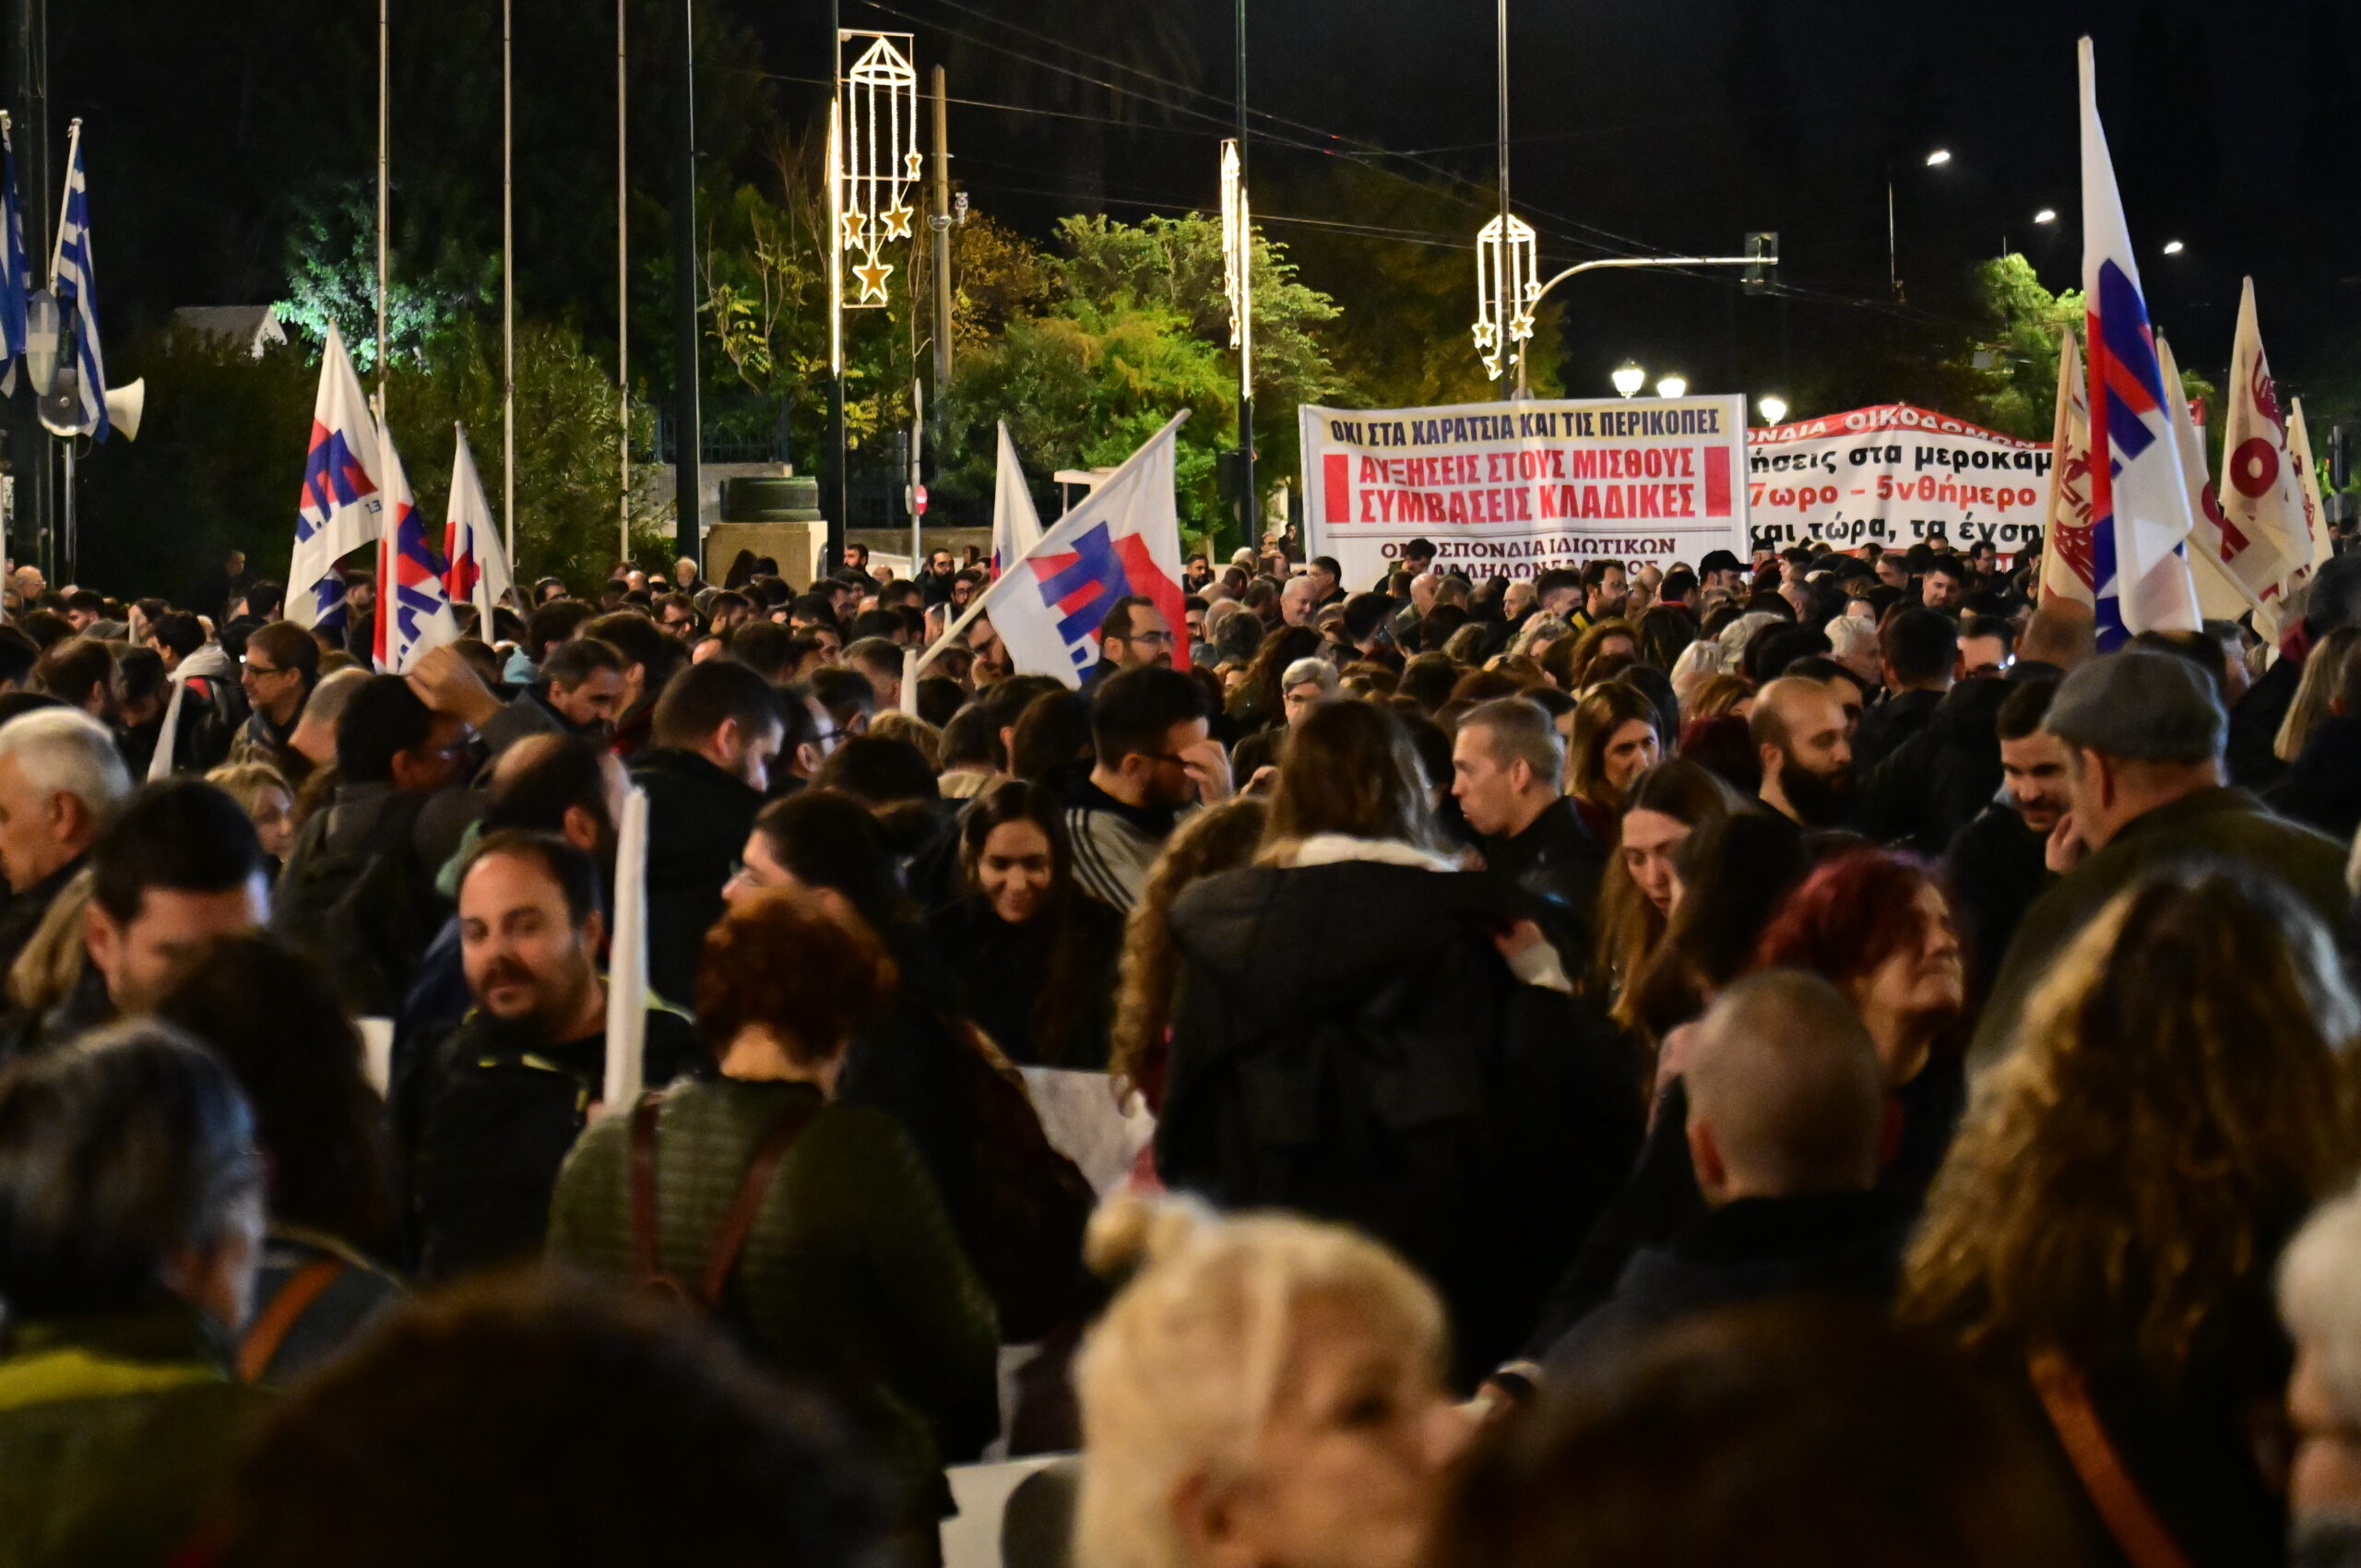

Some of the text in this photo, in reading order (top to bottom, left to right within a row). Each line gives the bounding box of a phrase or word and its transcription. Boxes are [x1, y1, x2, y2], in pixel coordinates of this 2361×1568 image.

[1369, 422, 1406, 447] ΣΤΑ
[1412, 413, 1515, 445] ΧΑΡΑΤΣΙΑ
[1520, 411, 1557, 438] ΚΑΙ
[1561, 411, 1595, 436] ΤΙΣ
[1600, 408, 1720, 436] ΠΕΡΙΚΟΠΕΣ
[1359, 446, 1695, 487] ΑΥΞΗΣΕΙΣ ΣΤΟΥΣ ΜΙΣΘΟΥΣ
[1748, 447, 1837, 474] ήσεις
[1849, 445, 1902, 466] στα
[1359, 482, 1696, 525] ΣΥΜΒΑΣΕΙΣ ΚΛΑΔΙΚΕΣ
[1749, 482, 1838, 512] 7ωρο
[1876, 473, 2037, 513] 5νθήμερο
[1808, 511, 1896, 544] τώρα,
[1910, 519, 1946, 539] τα
[1959, 511, 2046, 543] ένση
[1381, 537, 1677, 558] ΟΣΠΟΝΔΙΑ ΙΔΙΩΤΙΚΩΝ
